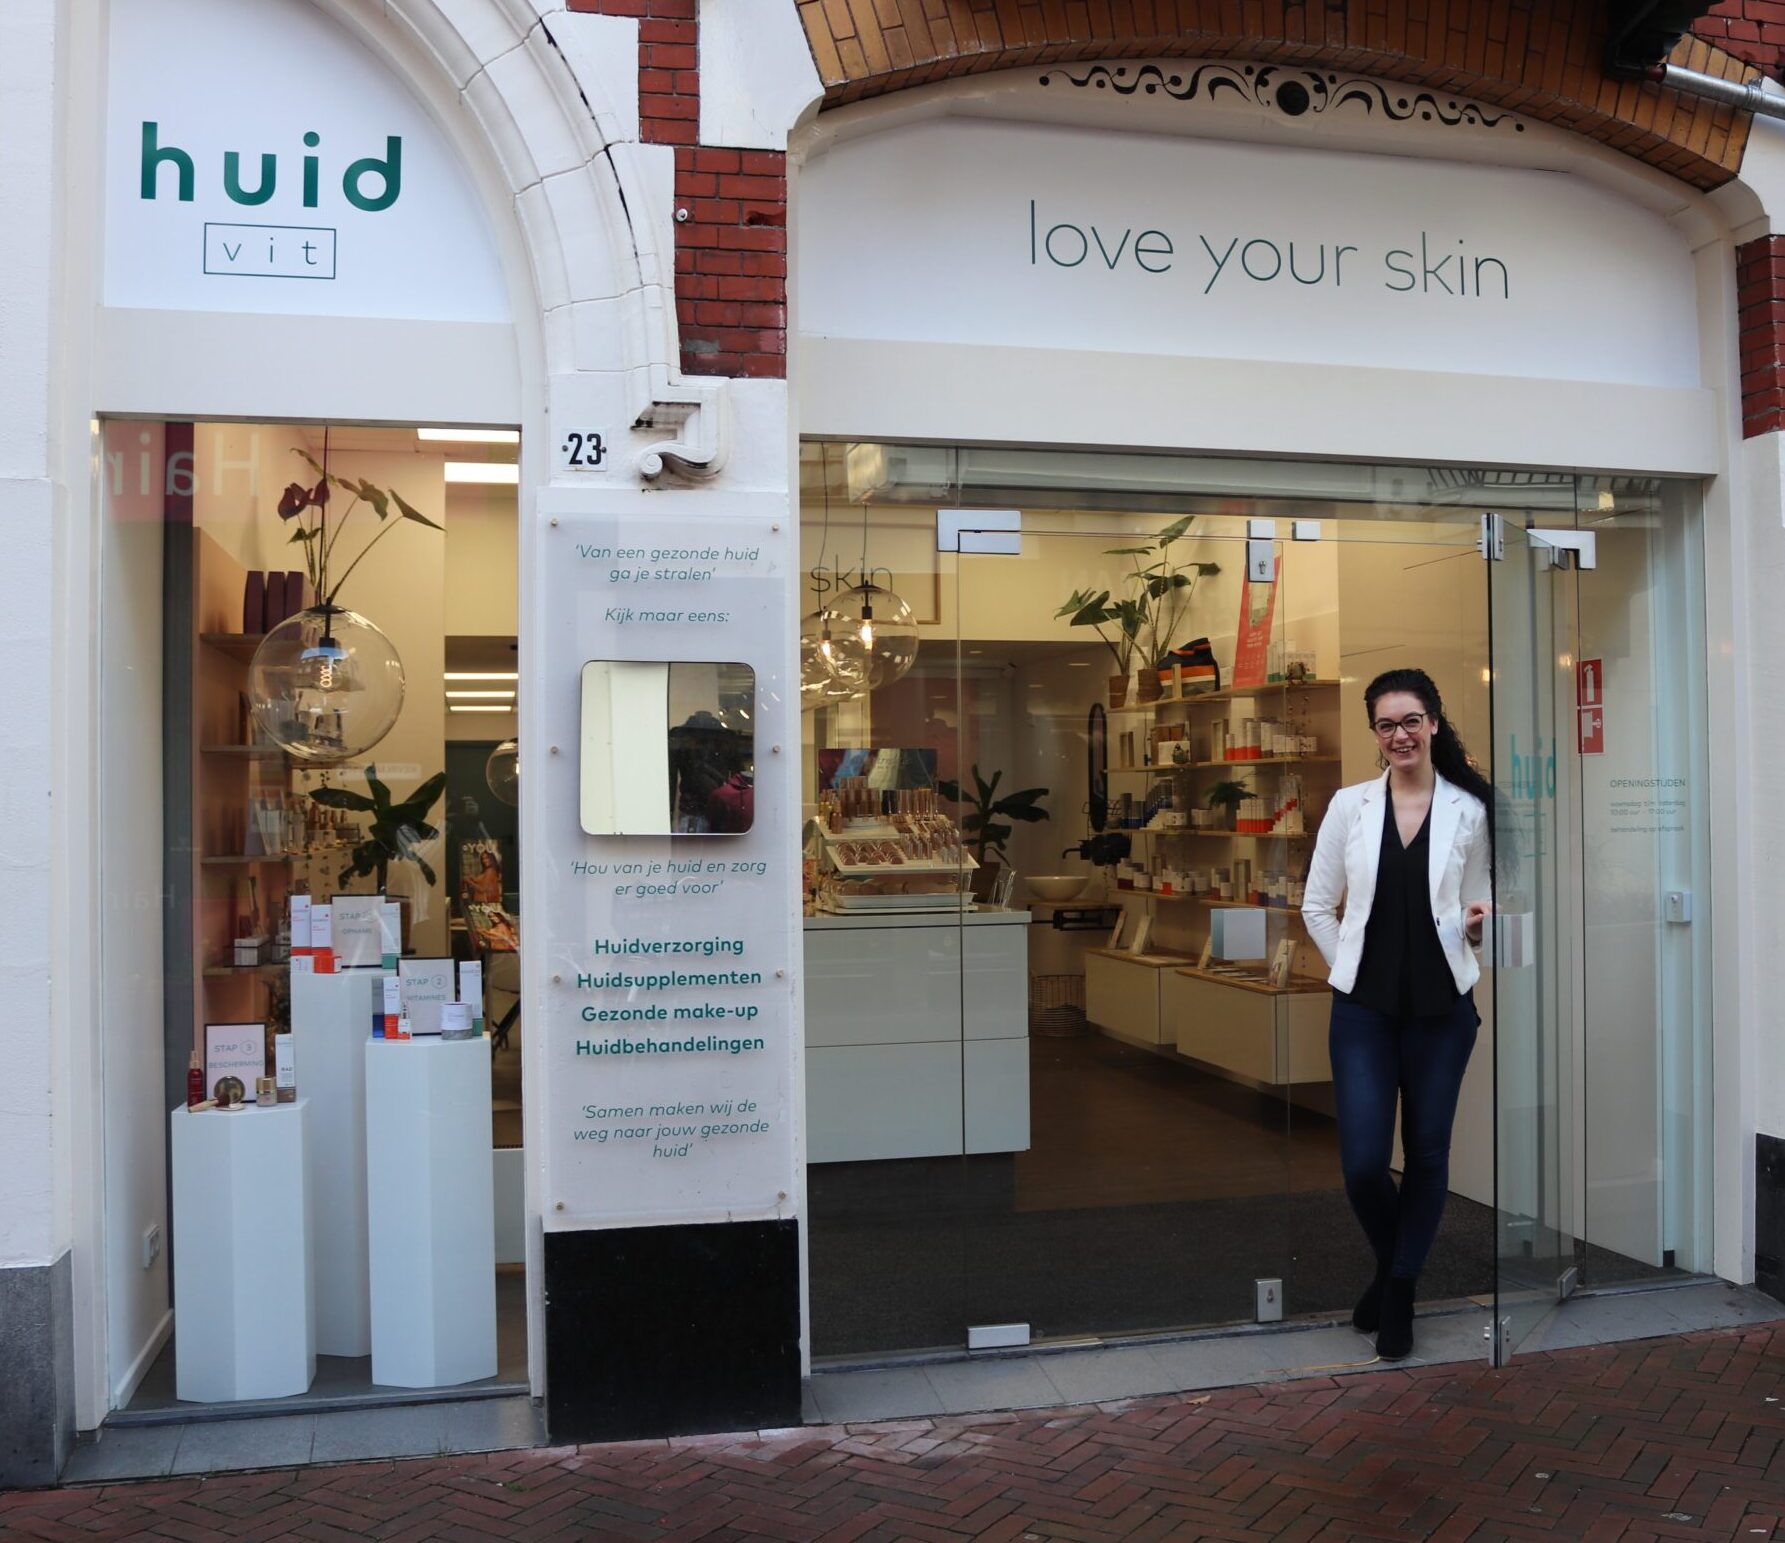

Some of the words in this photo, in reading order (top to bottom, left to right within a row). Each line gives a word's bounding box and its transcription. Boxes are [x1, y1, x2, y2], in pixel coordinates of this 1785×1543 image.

[141, 121, 402, 212] huid
[222, 237, 318, 265] vit
[1031, 200, 1174, 272] love
[1200, 230, 1358, 294] your
[1385, 231, 1509, 298] skin
[568, 433, 602, 465] 23
[616, 550, 646, 560] een
[650, 547, 720, 562] gezonde
[724, 548, 760, 561] huid
[609, 570, 631, 582] ga
[634, 567, 650, 583] je
[605, 608, 634, 624] Kijk
[639, 612, 684, 622] maar
[688, 612, 730, 622] eens:
[613, 864, 643, 874] van
[646, 862, 661, 876] je
[667, 860, 701, 873] huid
[706, 863, 725, 873] en
[731, 861, 767, 875] zorg
[615, 884, 632, 895] er
[636, 881, 677, 898] goed
[595, 937, 744, 956] Huidverzorging
[406, 978, 429, 986] STAP
[577, 971, 761, 990] Huidsupplementen
[581, 1005, 668, 1022] Gezonde
[673, 1003, 758, 1021] make-up
[214, 1044, 238, 1053] STAP
[576, 1036, 765, 1056] Huidbehandelingen
[650, 1102, 704, 1117] maken
[711, 1100, 732, 1116] wij
[737, 1099, 757, 1113] de
[574, 1130, 609, 1143] weg
[614, 1127, 652, 1139] naar
[655, 1123, 697, 1139] jouw
[701, 1120, 769, 1138] gezonde
